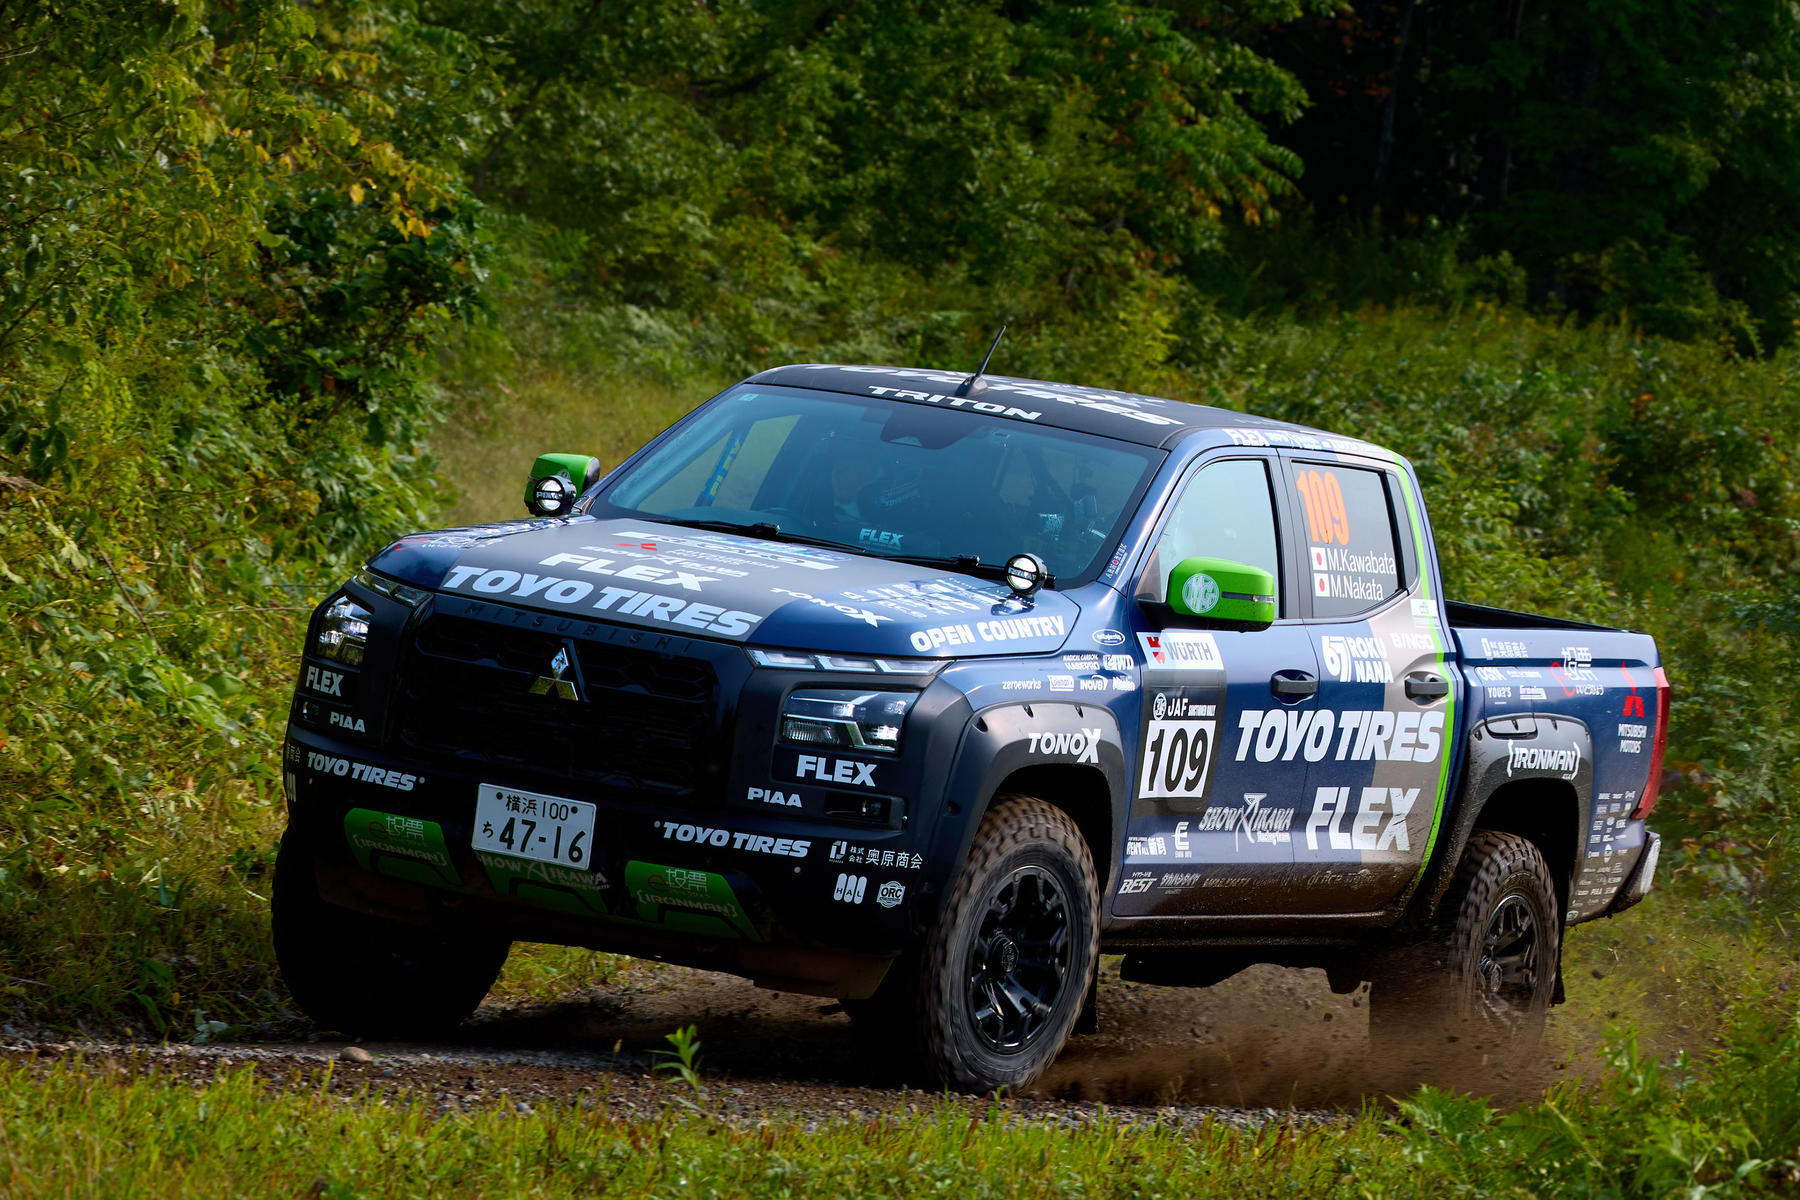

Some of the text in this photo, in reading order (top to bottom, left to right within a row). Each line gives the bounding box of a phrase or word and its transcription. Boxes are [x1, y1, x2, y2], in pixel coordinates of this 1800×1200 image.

[868, 385, 1042, 421] TRITON
[1296, 469, 1350, 546] 109
[859, 527, 904, 547] FLEX
[538, 552, 723, 592] FLEX
[1327, 548, 1397, 575] M.Kawabata
[442, 565, 763, 637] TOYO TIRES
[1330, 573, 1384, 601] M.Nakata
[769, 586, 895, 628] TONOX
[464, 602, 693, 654] MITSUBISHI
[909, 614, 1066, 653] OPEN COUNTRY
[1345, 636, 1388, 659] ROKU
[306, 665, 344, 697] FLEX
[1353, 660, 1394, 684] NANA
[330, 711, 367, 733] PIAA
[1167, 698, 1189, 717] JAF
[1028, 727, 1102, 764] TONOX
[1235, 709, 1445, 763] TOYO TIRES
[307, 752, 350, 777] TOYO
[350, 763, 418, 791] TIRES
[796, 755, 878, 788] FLEX
[1148, 727, 1208, 793] 109
[1513, 747, 1576, 771] IRONMAN
[505, 793, 569, 821] 横浜 100
[747, 787, 803, 808] PIAA
[1198, 806, 1242, 831] SHOW
[1305, 786, 1421, 851] FLEX
[481, 817, 587, 864] ち 47-16
[663, 821, 811, 857] TOYO TIRES
[865, 848, 923, 869] 奥原商会
[881, 887, 902, 899] ORC
[1117, 878, 1158, 894] BEST
